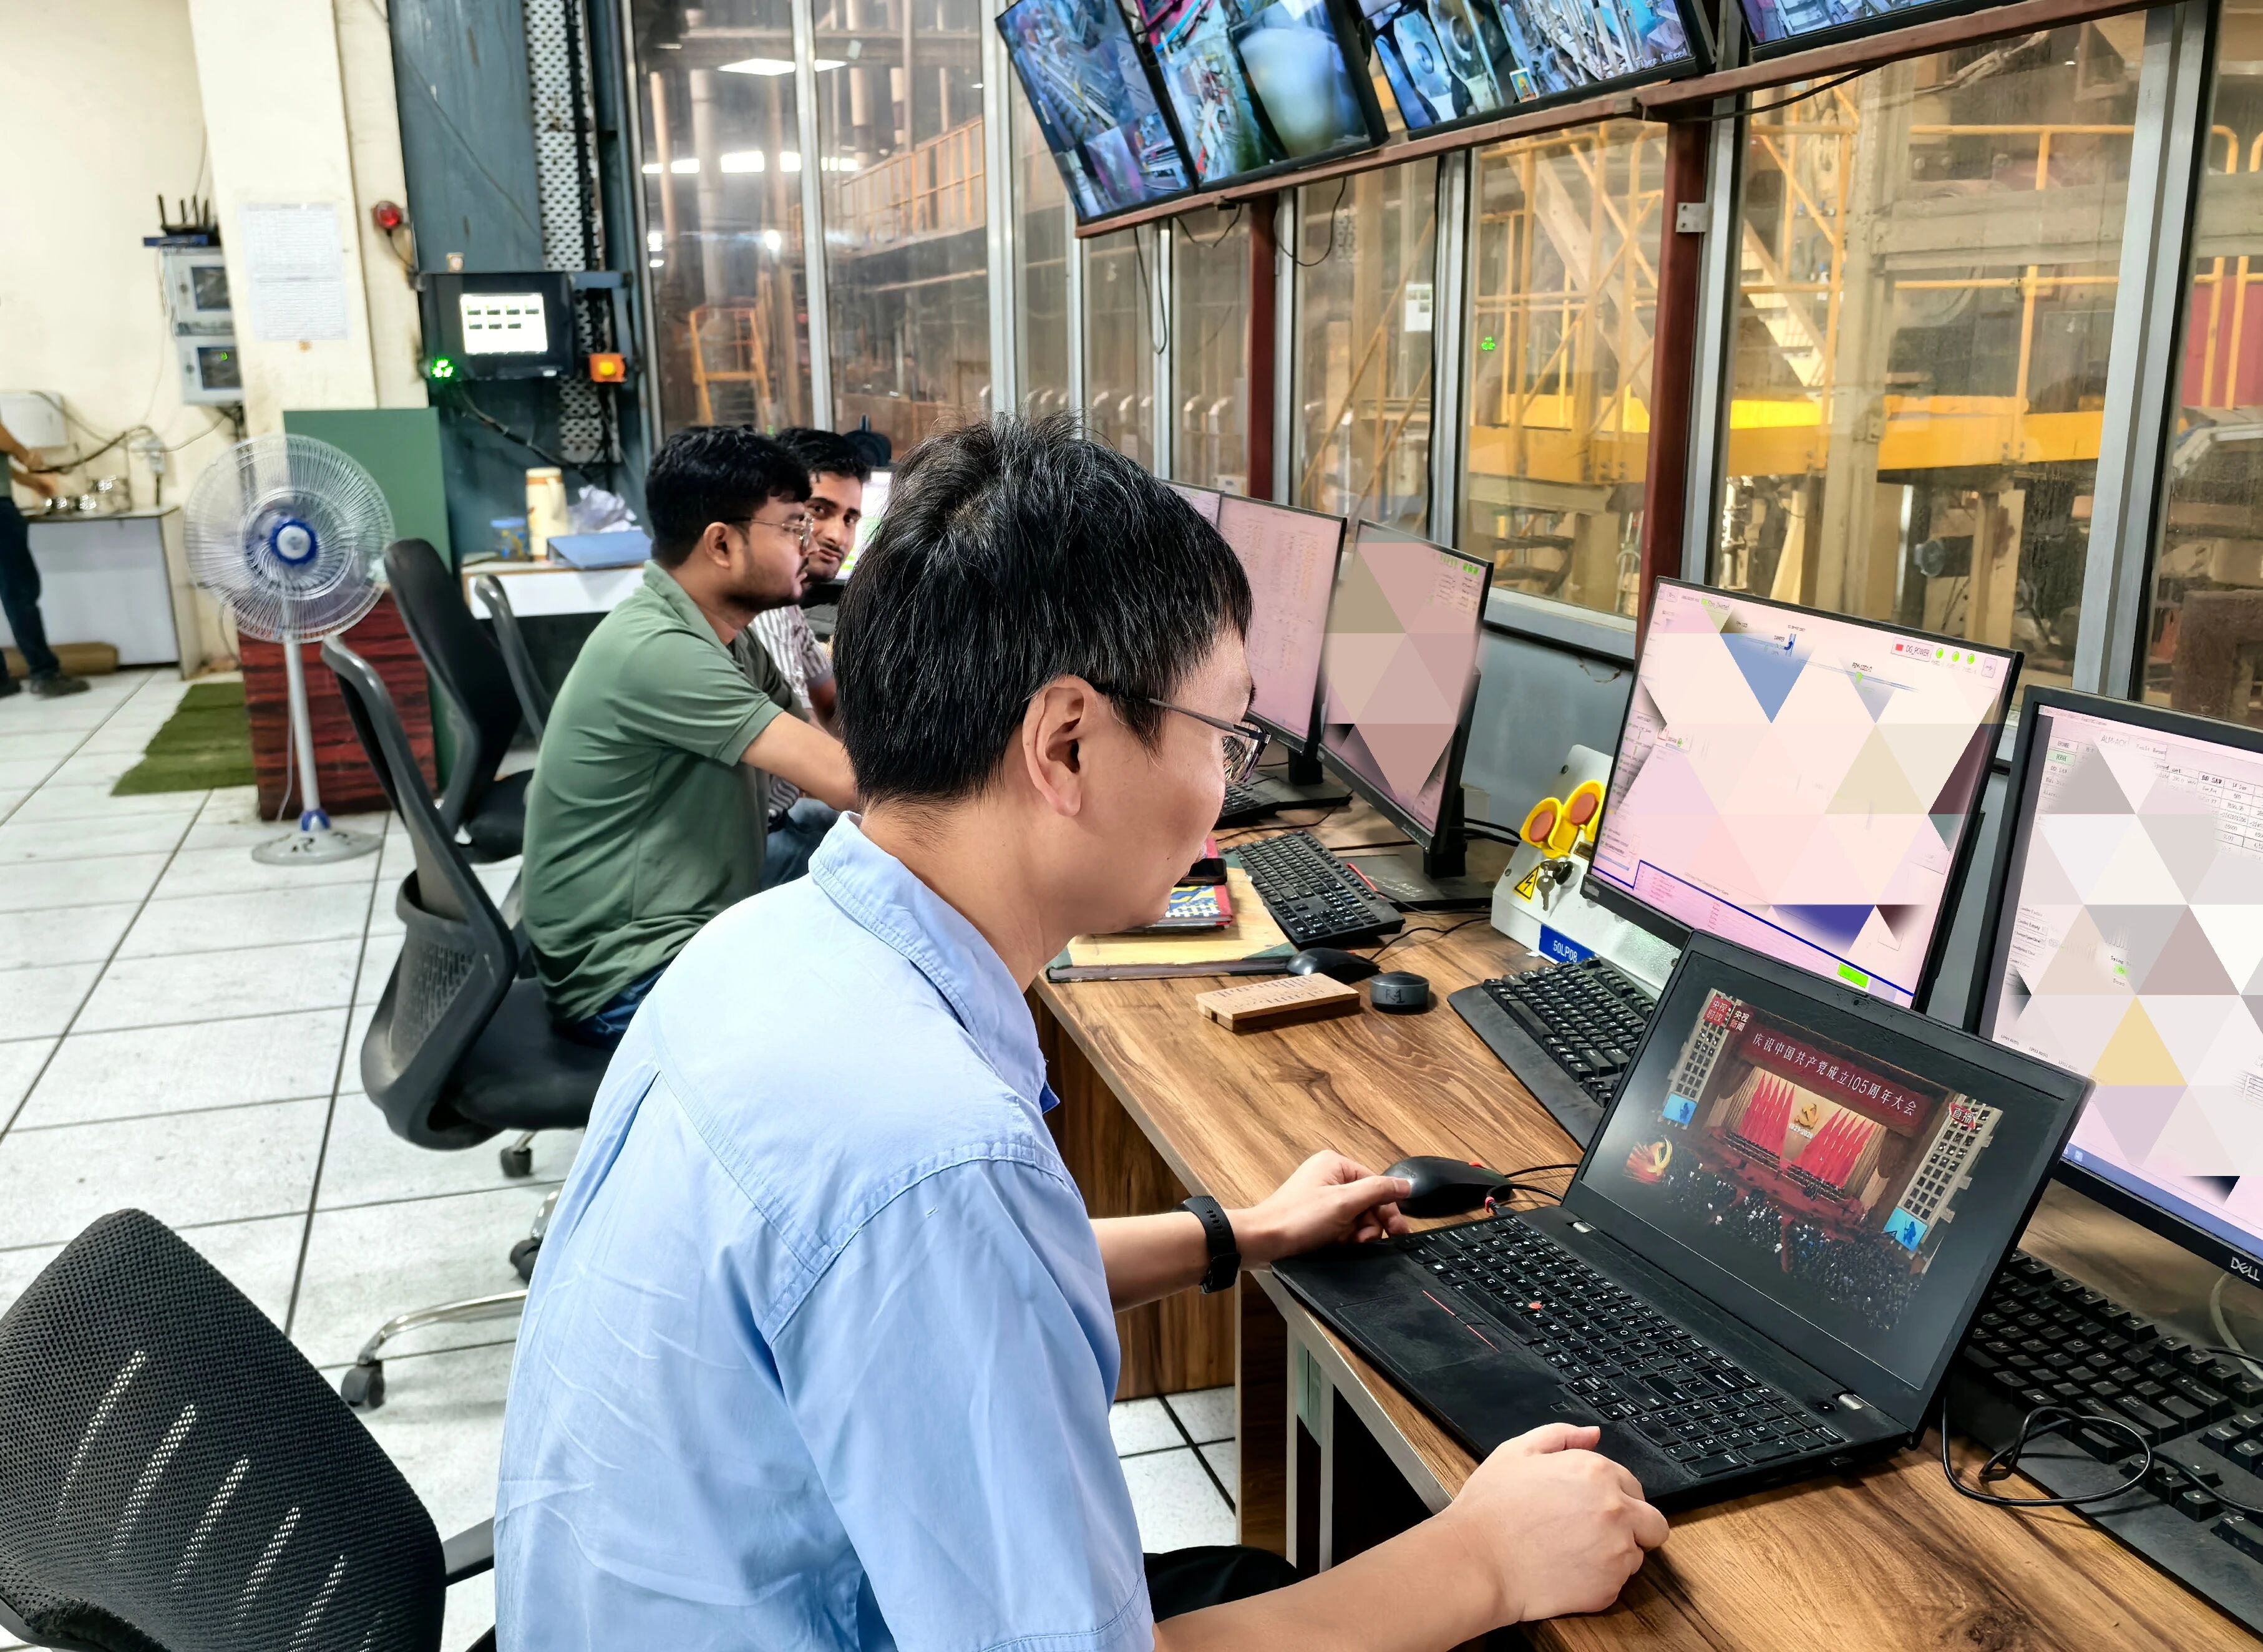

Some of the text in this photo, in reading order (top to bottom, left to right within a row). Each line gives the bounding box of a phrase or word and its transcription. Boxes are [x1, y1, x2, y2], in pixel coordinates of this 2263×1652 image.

[1752, 1033, 1917, 1116] 庆祝中国共产党成立105周年大会
[2231, 1256, 2260, 1281] DELL
